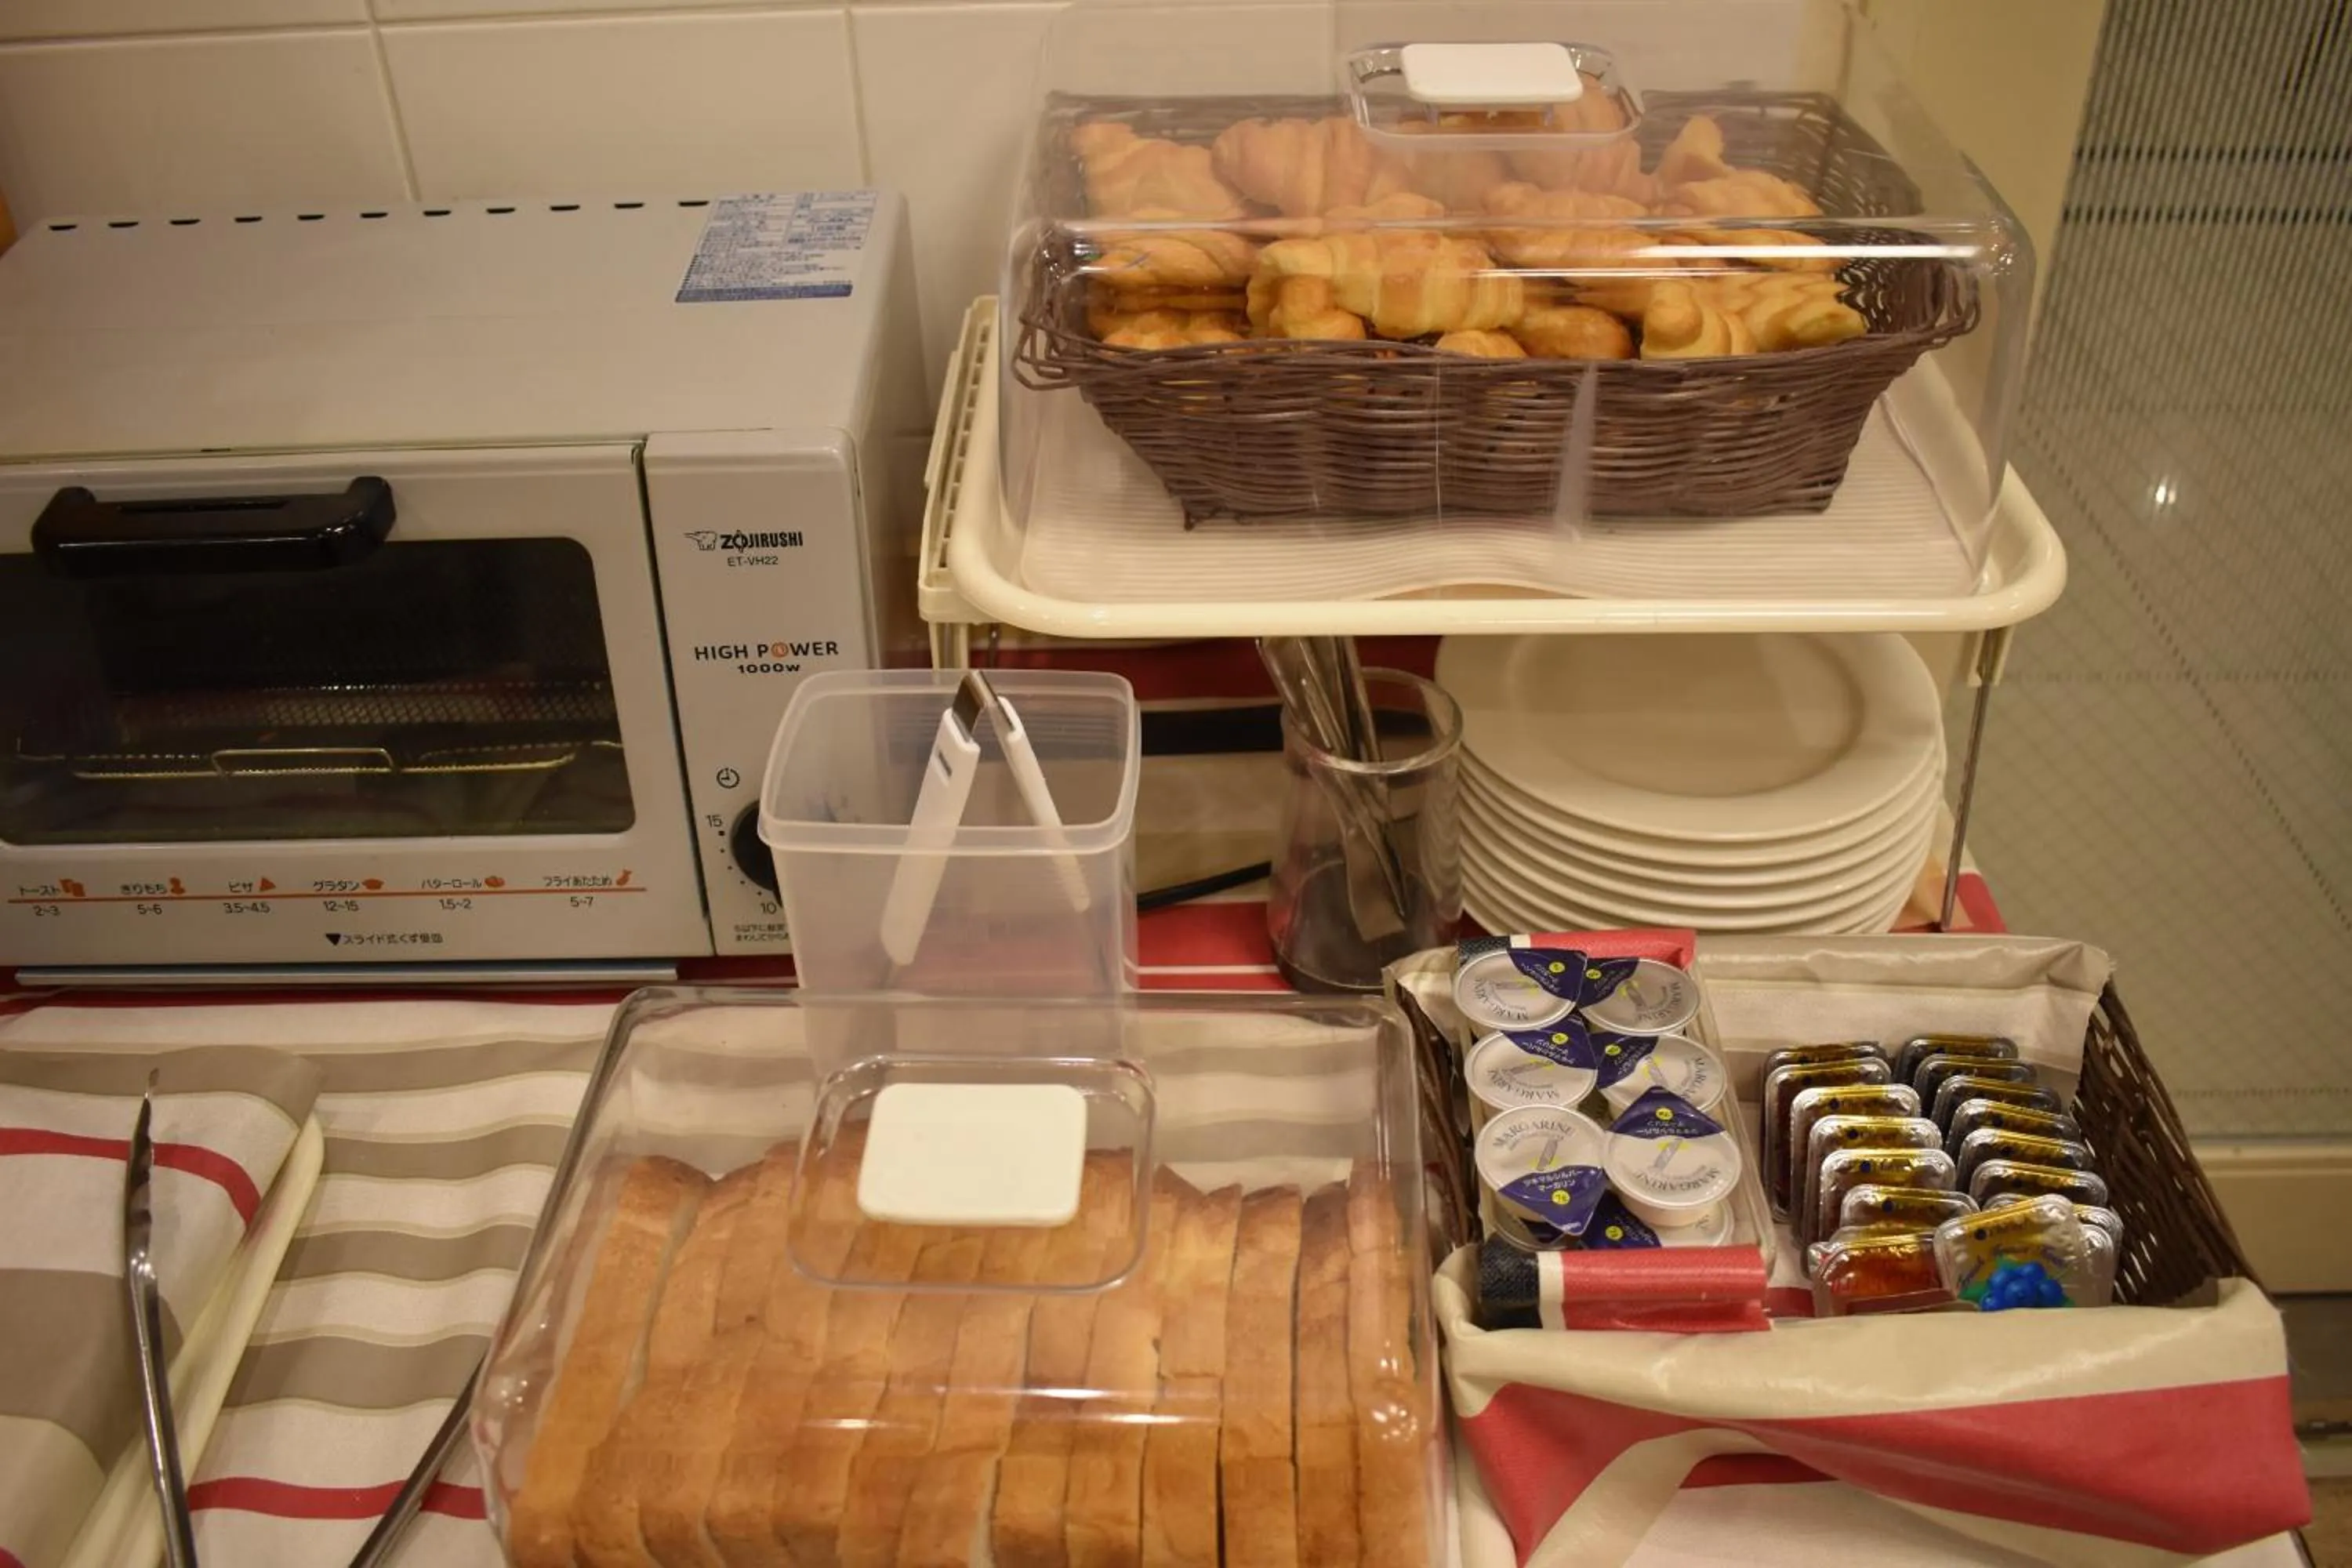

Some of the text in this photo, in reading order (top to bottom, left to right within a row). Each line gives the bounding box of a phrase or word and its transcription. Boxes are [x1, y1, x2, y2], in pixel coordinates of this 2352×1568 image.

[720, 530, 804, 552] ZOJIRUSHI
[727, 555, 779, 567] ET-VH22
[695, 641, 839, 660] HIGH POWER
[706, 814, 723, 828] 15
[313, 879, 360, 891] グラタン
[542, 875, 613, 887] フライあたため
[19, 885, 61, 896] トースト
[760, 902, 777, 914] 10
